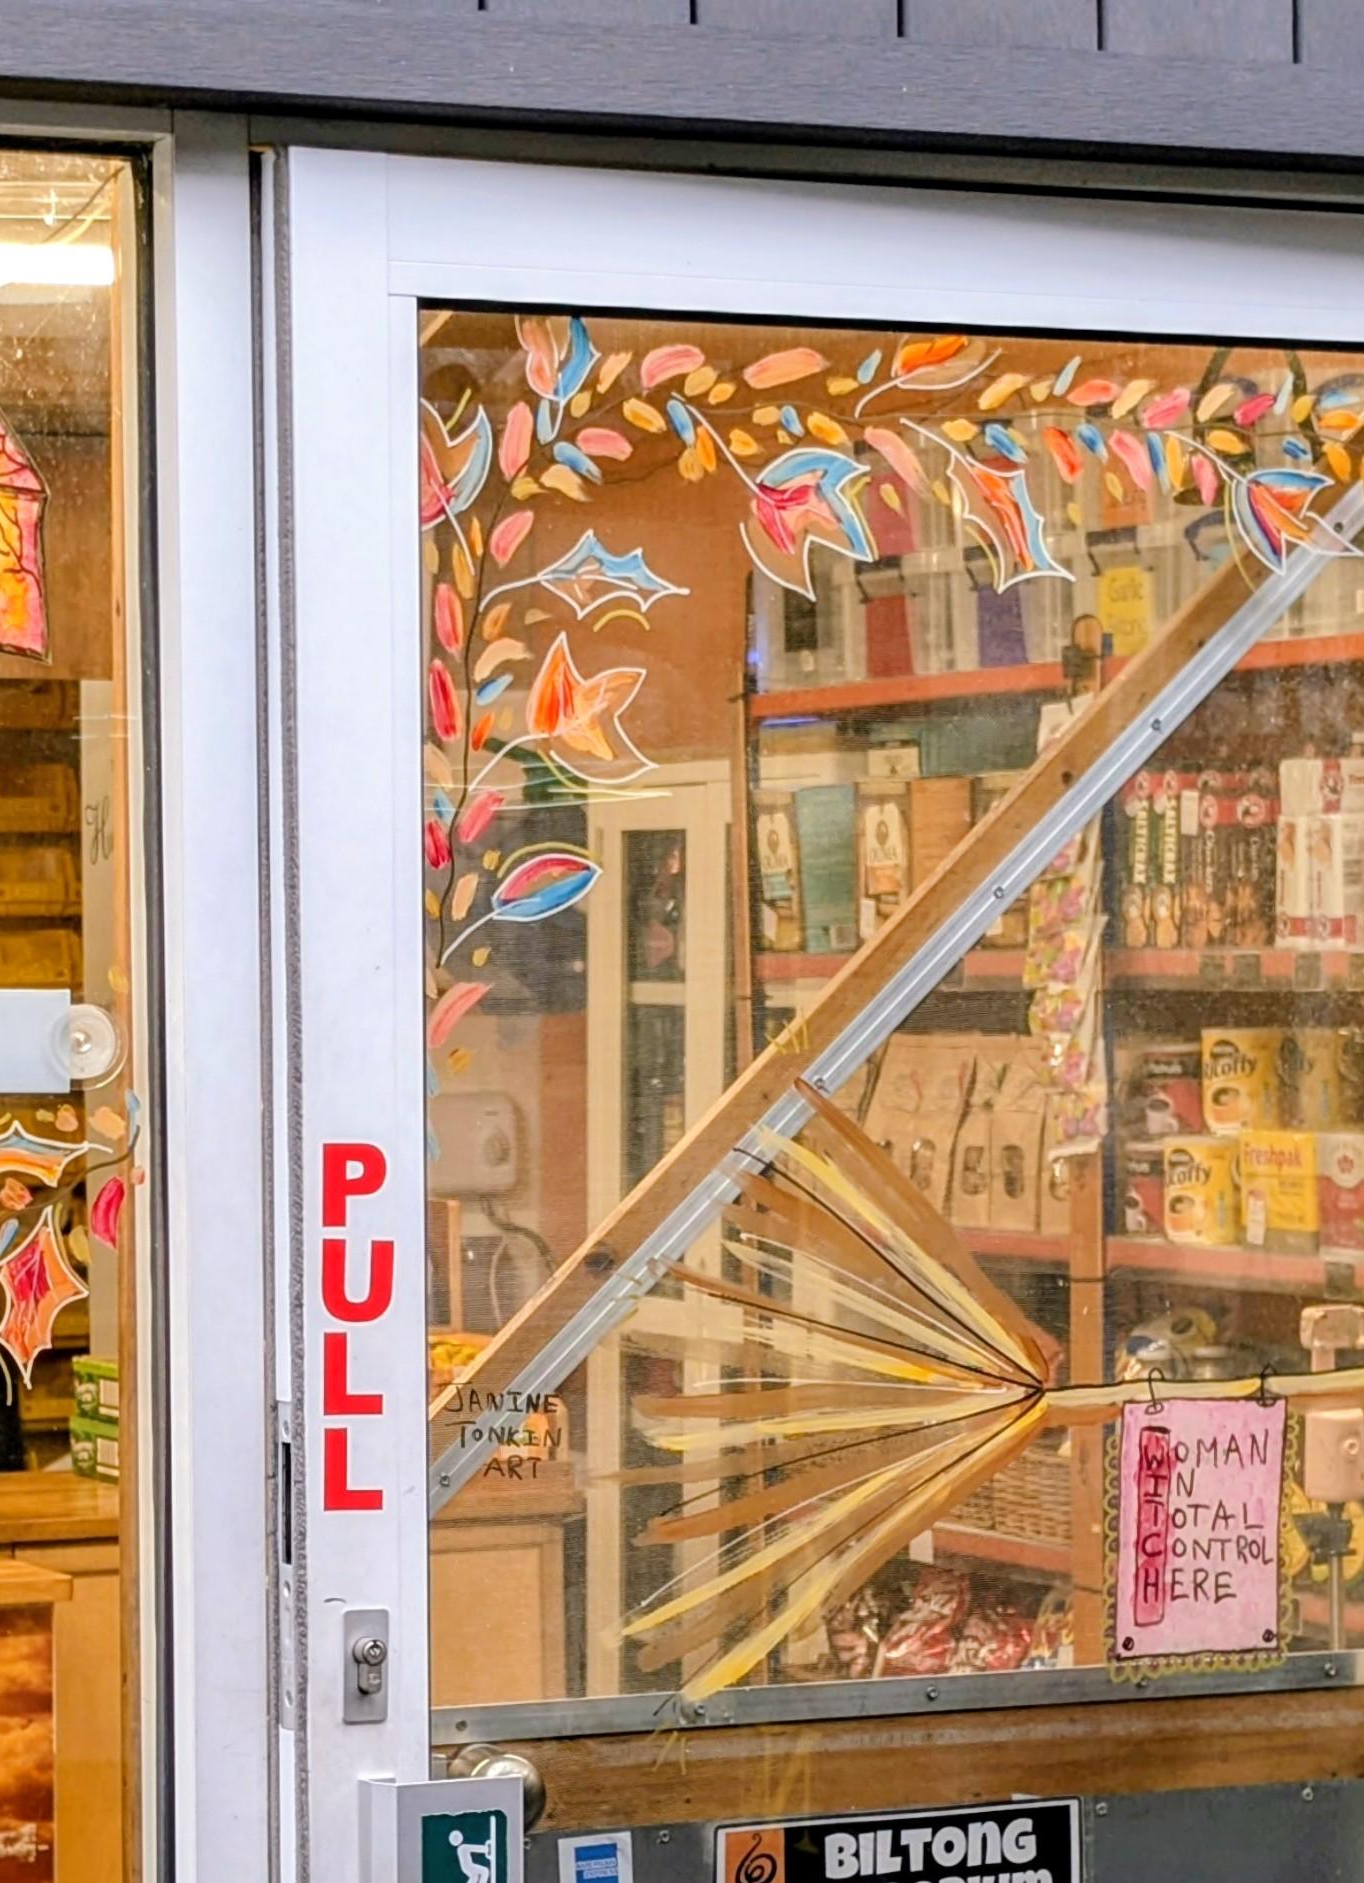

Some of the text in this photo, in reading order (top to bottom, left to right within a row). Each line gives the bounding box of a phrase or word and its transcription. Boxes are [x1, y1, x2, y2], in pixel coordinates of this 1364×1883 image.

[321, 1143, 394, 1511] PULL
[436, 1381, 560, 1413] JANINE
[444, 1421, 562, 1448] TONKIN
[1143, 1428, 1269, 1471] WOMAN
[483, 1454, 541, 1480] ART
[1143, 1468, 1195, 1498] IN
[1144, 1498, 1264, 1531] TOTAL
[1141, 1532, 1273, 1565] CONTROL
[1143, 1567, 1237, 1604] HERE
[824, 1817, 1037, 1881] BILTONG
